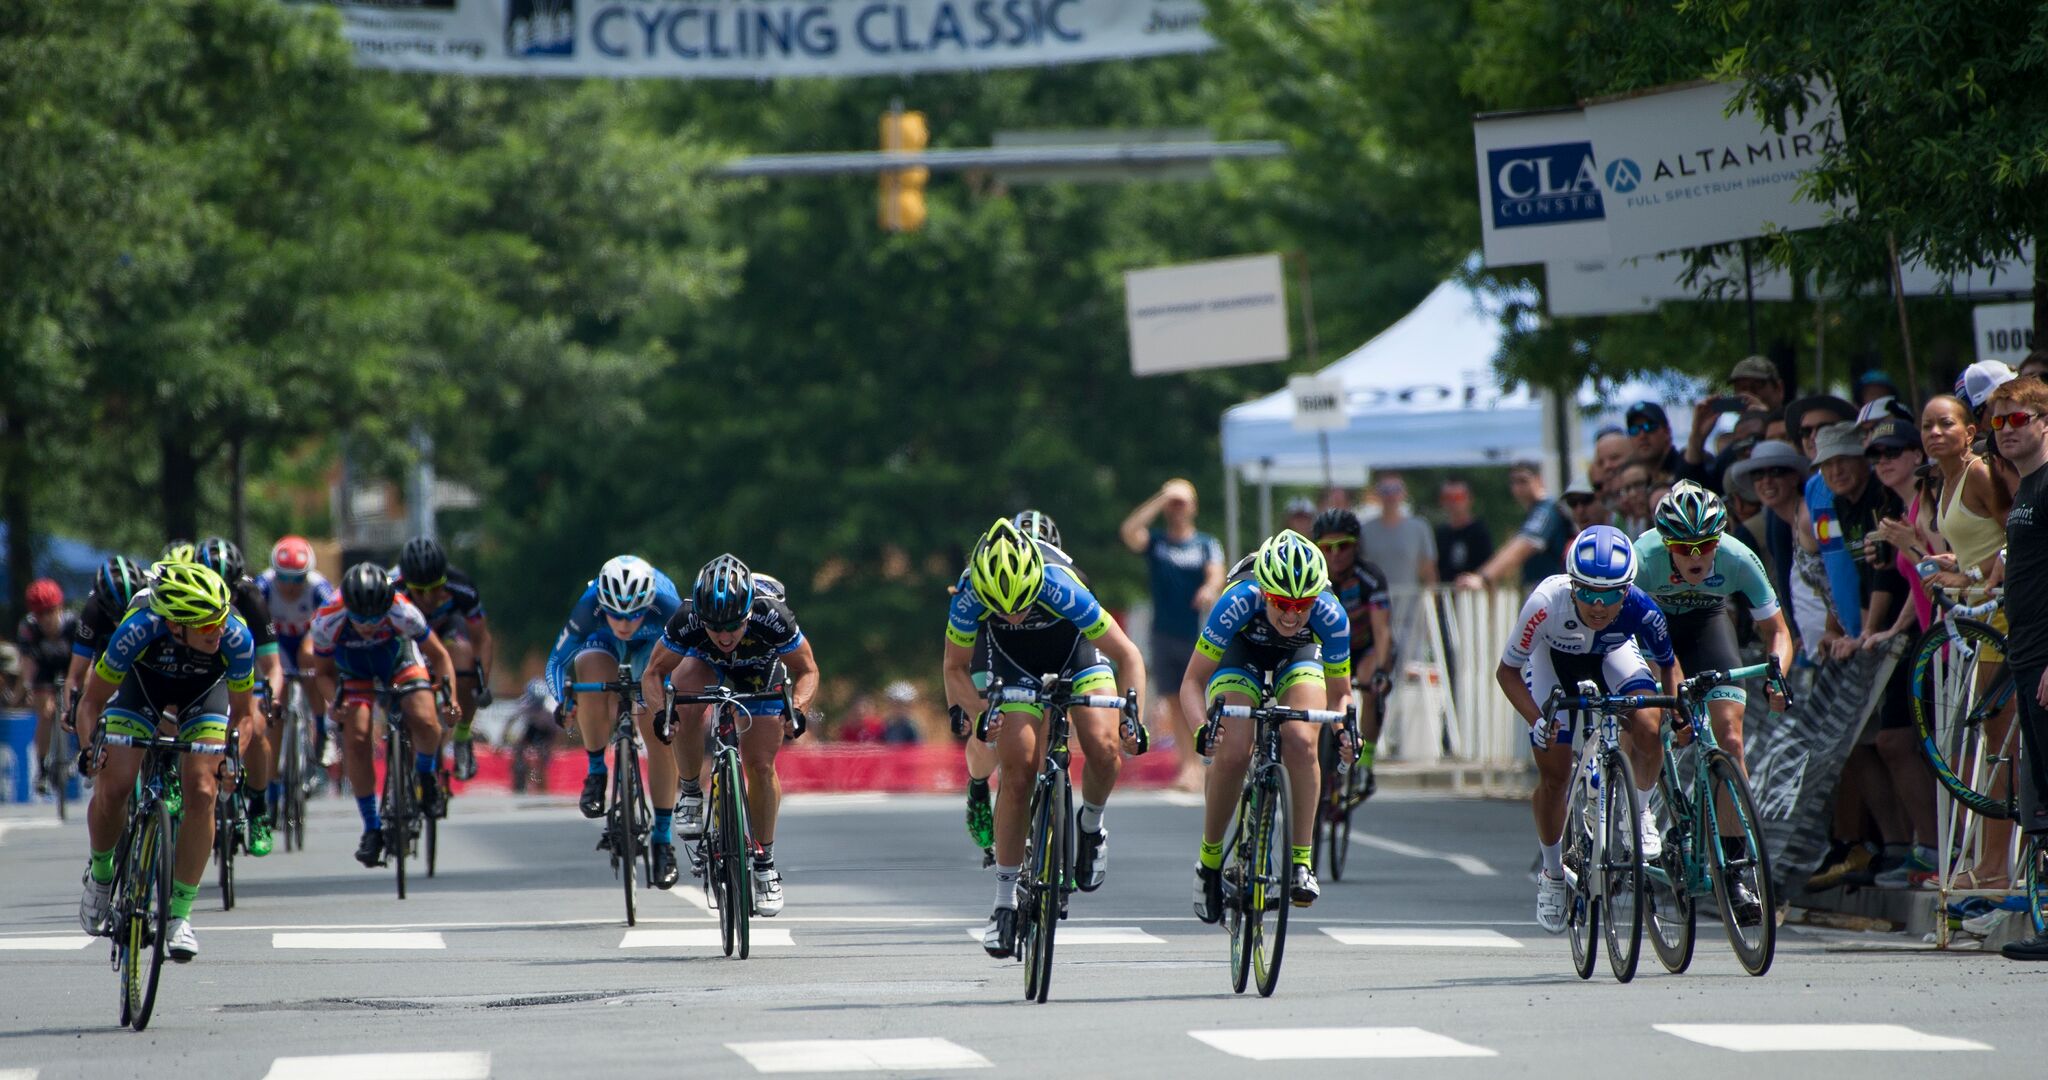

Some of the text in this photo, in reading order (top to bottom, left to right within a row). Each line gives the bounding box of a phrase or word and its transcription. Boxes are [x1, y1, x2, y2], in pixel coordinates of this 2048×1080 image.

[591, 0, 1083, 57] CYCLING CLASSIC
[1498, 153, 1601, 199] CLA
[1654, 134, 1843, 182] ALTAMIRA
[1627, 169, 1806, 208] FULL SPECTRUM INNOVA
[1219, 594, 1250, 630] svb
[1315, 597, 1341, 627] vb
[1519, 607, 1549, 651] MAXXIS
[1652, 613, 1669, 642] UHC
[115, 621, 148, 657] svb
[1204, 625, 1230, 647] OVAL
[1552, 639, 1583, 651] UHC
